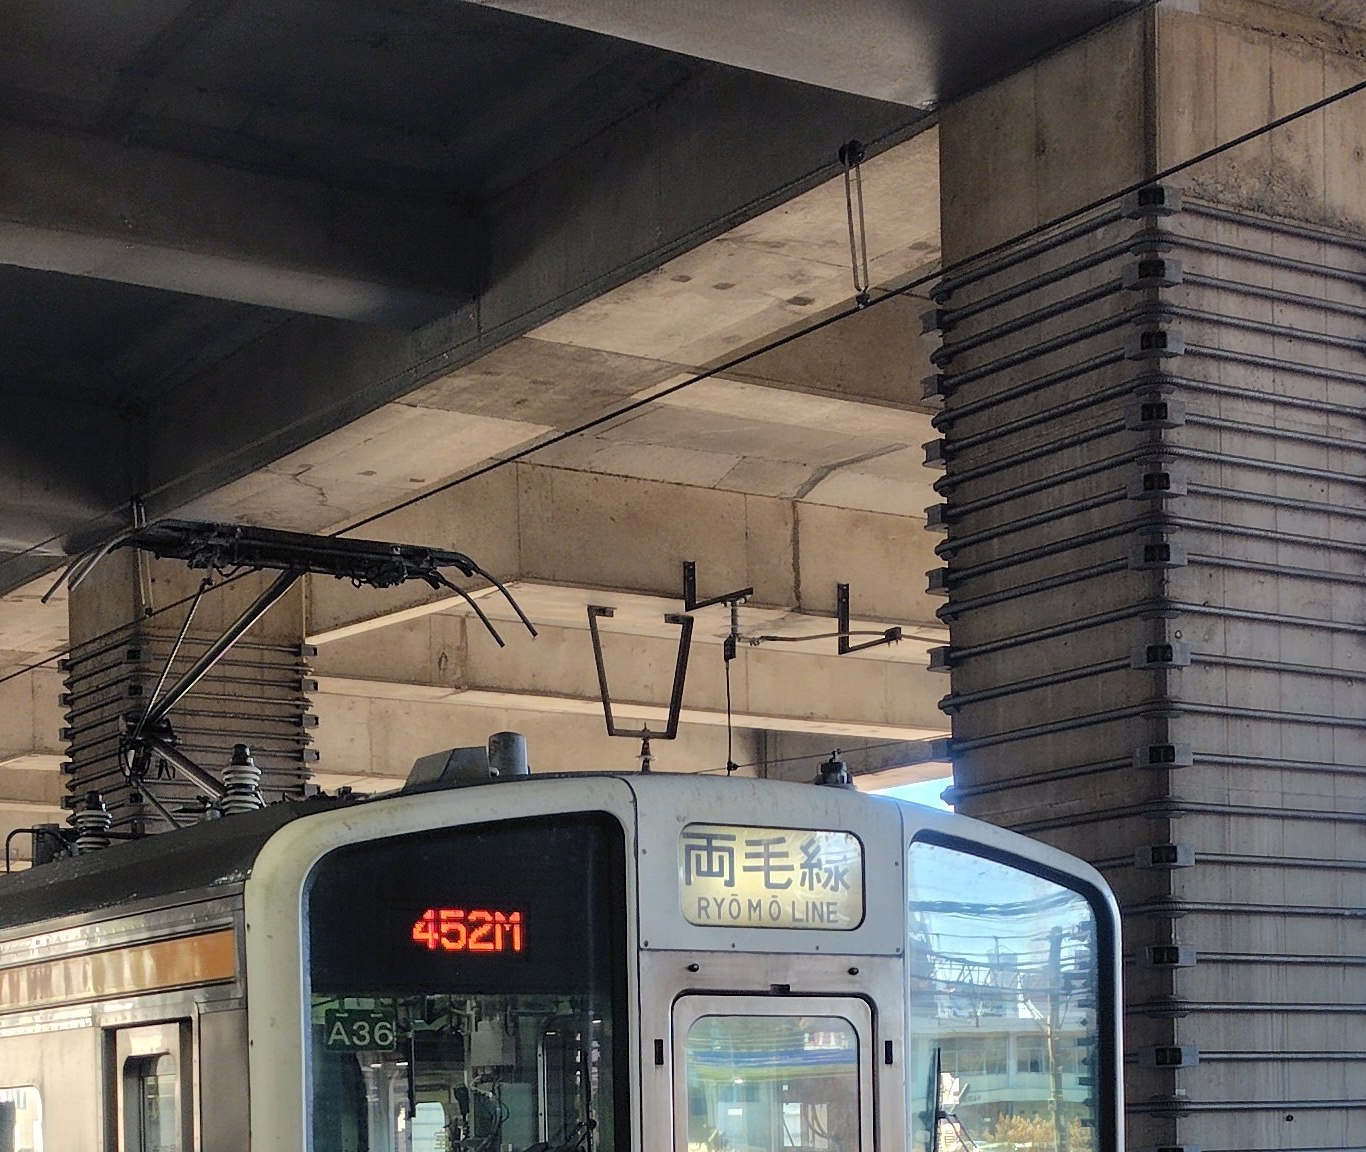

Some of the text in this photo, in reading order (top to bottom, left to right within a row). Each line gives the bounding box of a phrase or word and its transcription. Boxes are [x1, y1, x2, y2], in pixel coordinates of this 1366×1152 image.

[682, 832, 851, 892] 両毛線
[412, 908, 522, 951] 452M
[792, 901, 839, 924] LINE
[327, 1021, 395, 1046] A36
